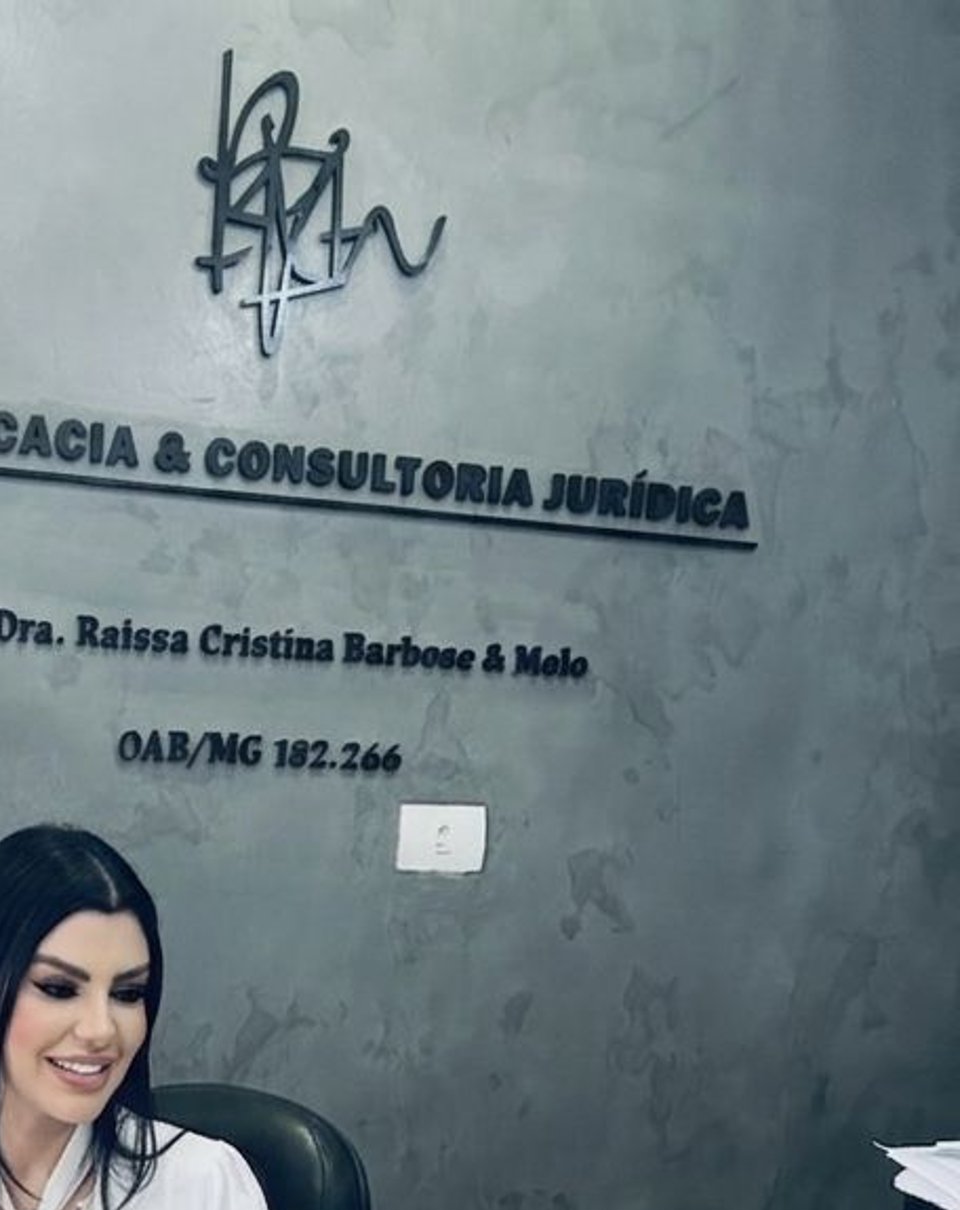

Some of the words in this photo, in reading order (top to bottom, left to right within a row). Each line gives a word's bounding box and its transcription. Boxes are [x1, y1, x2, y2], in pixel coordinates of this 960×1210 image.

[154, 431, 191, 474] &
[203, 436, 534, 508] CONSULTORIA
[542, 470, 752, 530] JURÍDICA
[75, 614, 190, 654] Raissa
[199, 624, 334, 662] Cristina
[481, 643, 506, 673] &
[118, 729, 263, 769] OAB/MG
[273, 739, 403, 772] 182.266
